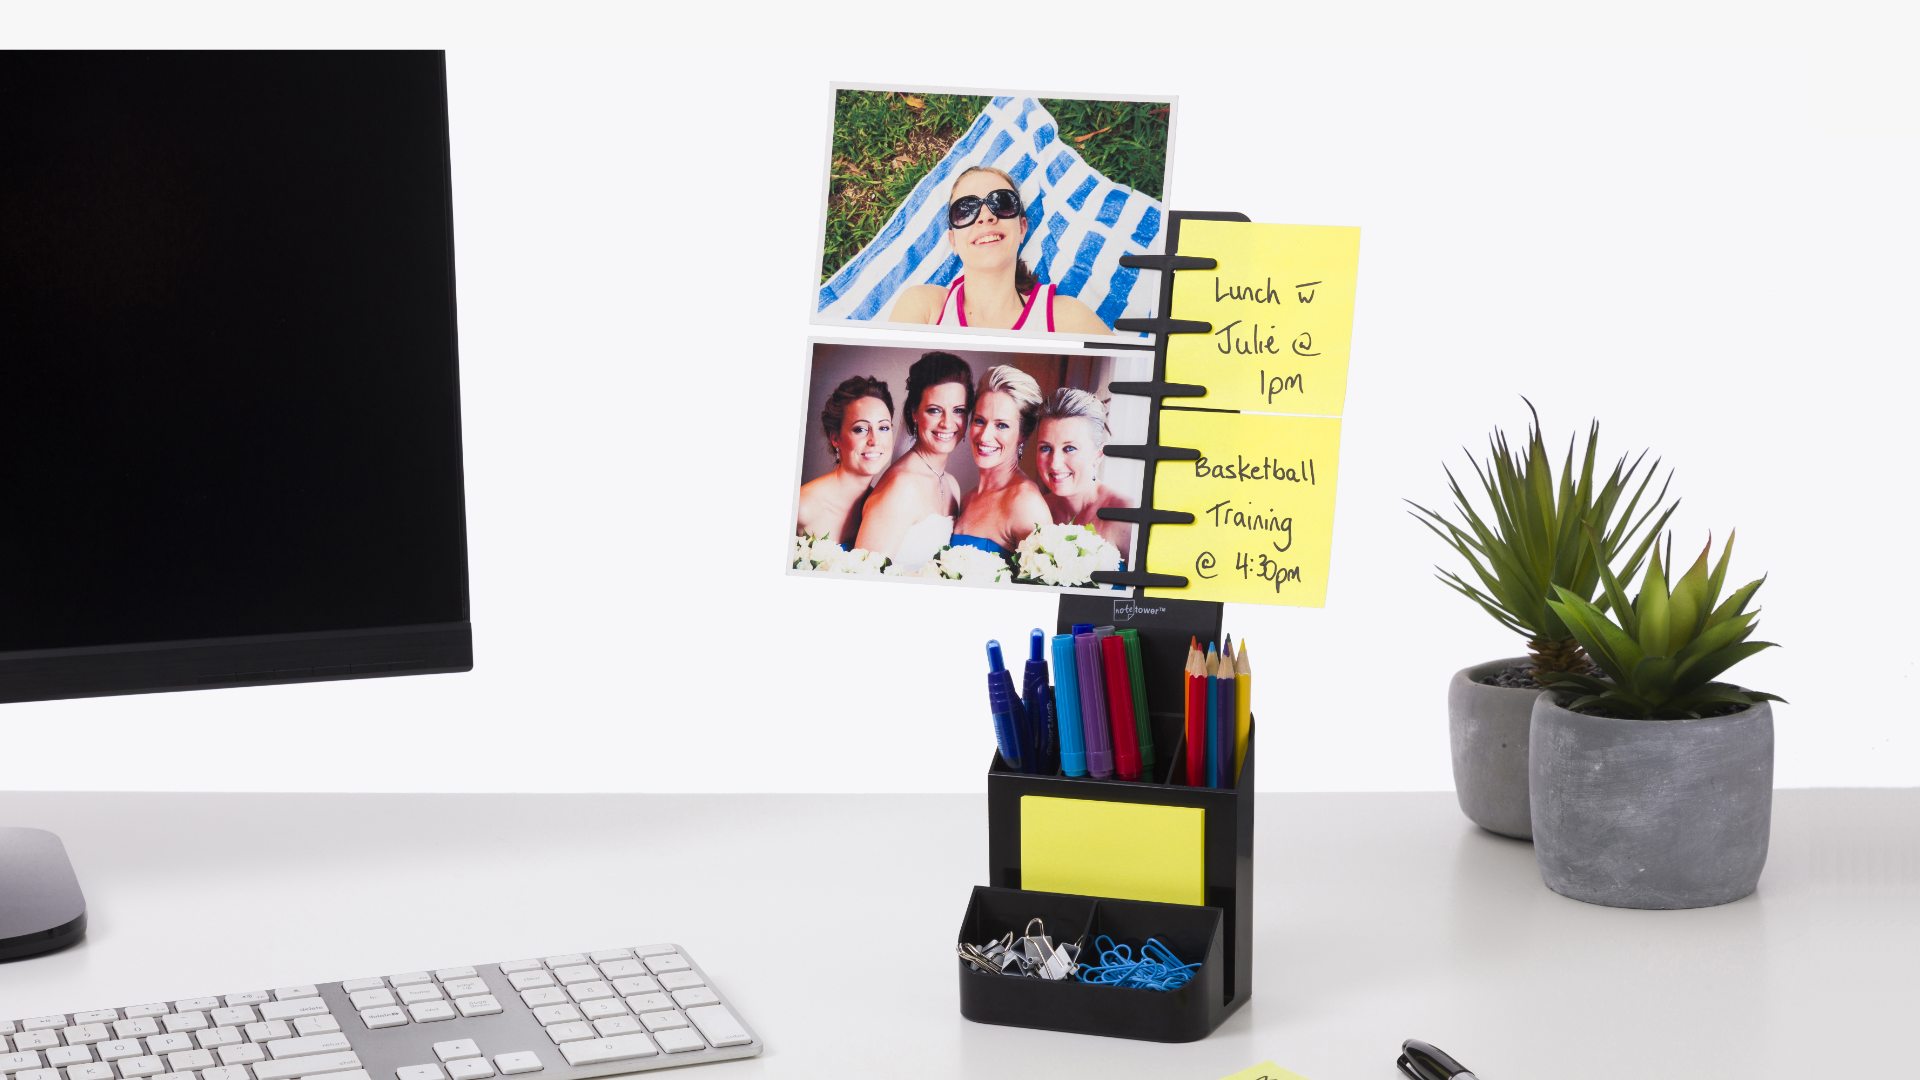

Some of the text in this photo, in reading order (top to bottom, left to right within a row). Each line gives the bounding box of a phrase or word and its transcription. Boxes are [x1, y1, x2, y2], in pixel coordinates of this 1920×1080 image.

[1215, 276, 1280, 305] Lunch
[1214, 319, 1322, 357] Julie @
[1260, 369, 1304, 405] 1pm
[1194, 454, 1316, 486] Basketball
[1205, 499, 1292, 553] Training
[1195, 551, 1302, 594] @ 4:30pm
